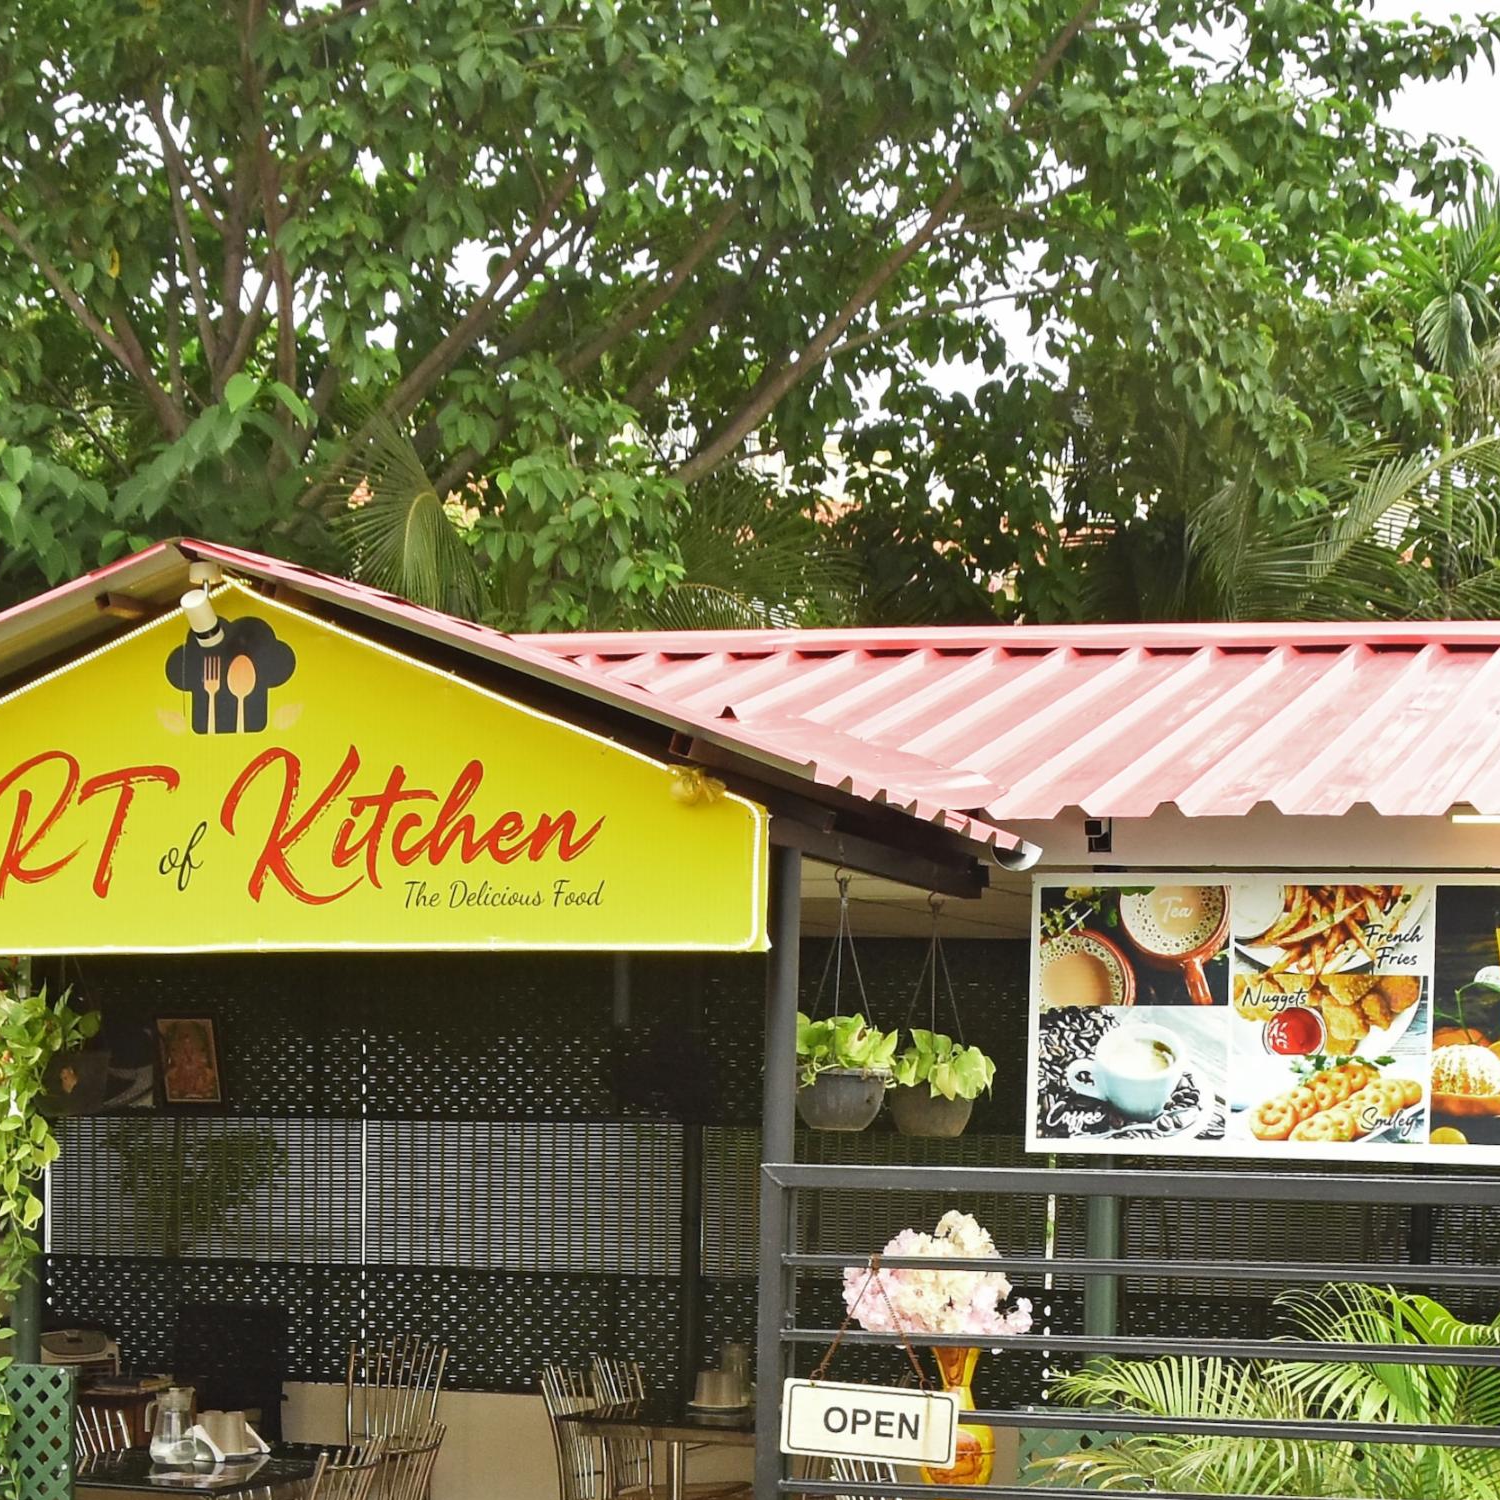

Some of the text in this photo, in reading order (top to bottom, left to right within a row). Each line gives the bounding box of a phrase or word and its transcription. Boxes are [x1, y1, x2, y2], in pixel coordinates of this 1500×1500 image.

[159, 821, 207, 891] of
[220, 744, 606, 905] Kitchen
[405, 879, 605, 908] The Delicious Food
[1159, 895, 1193, 924] Tea
[1363, 924, 1424, 946] French
[1375, 946, 1418, 968] Fries
[1242, 983, 1309, 1011] Nuggets
[1361, 1106, 1414, 1137] Smiley
[823, 1406, 920, 1441] OPEN
